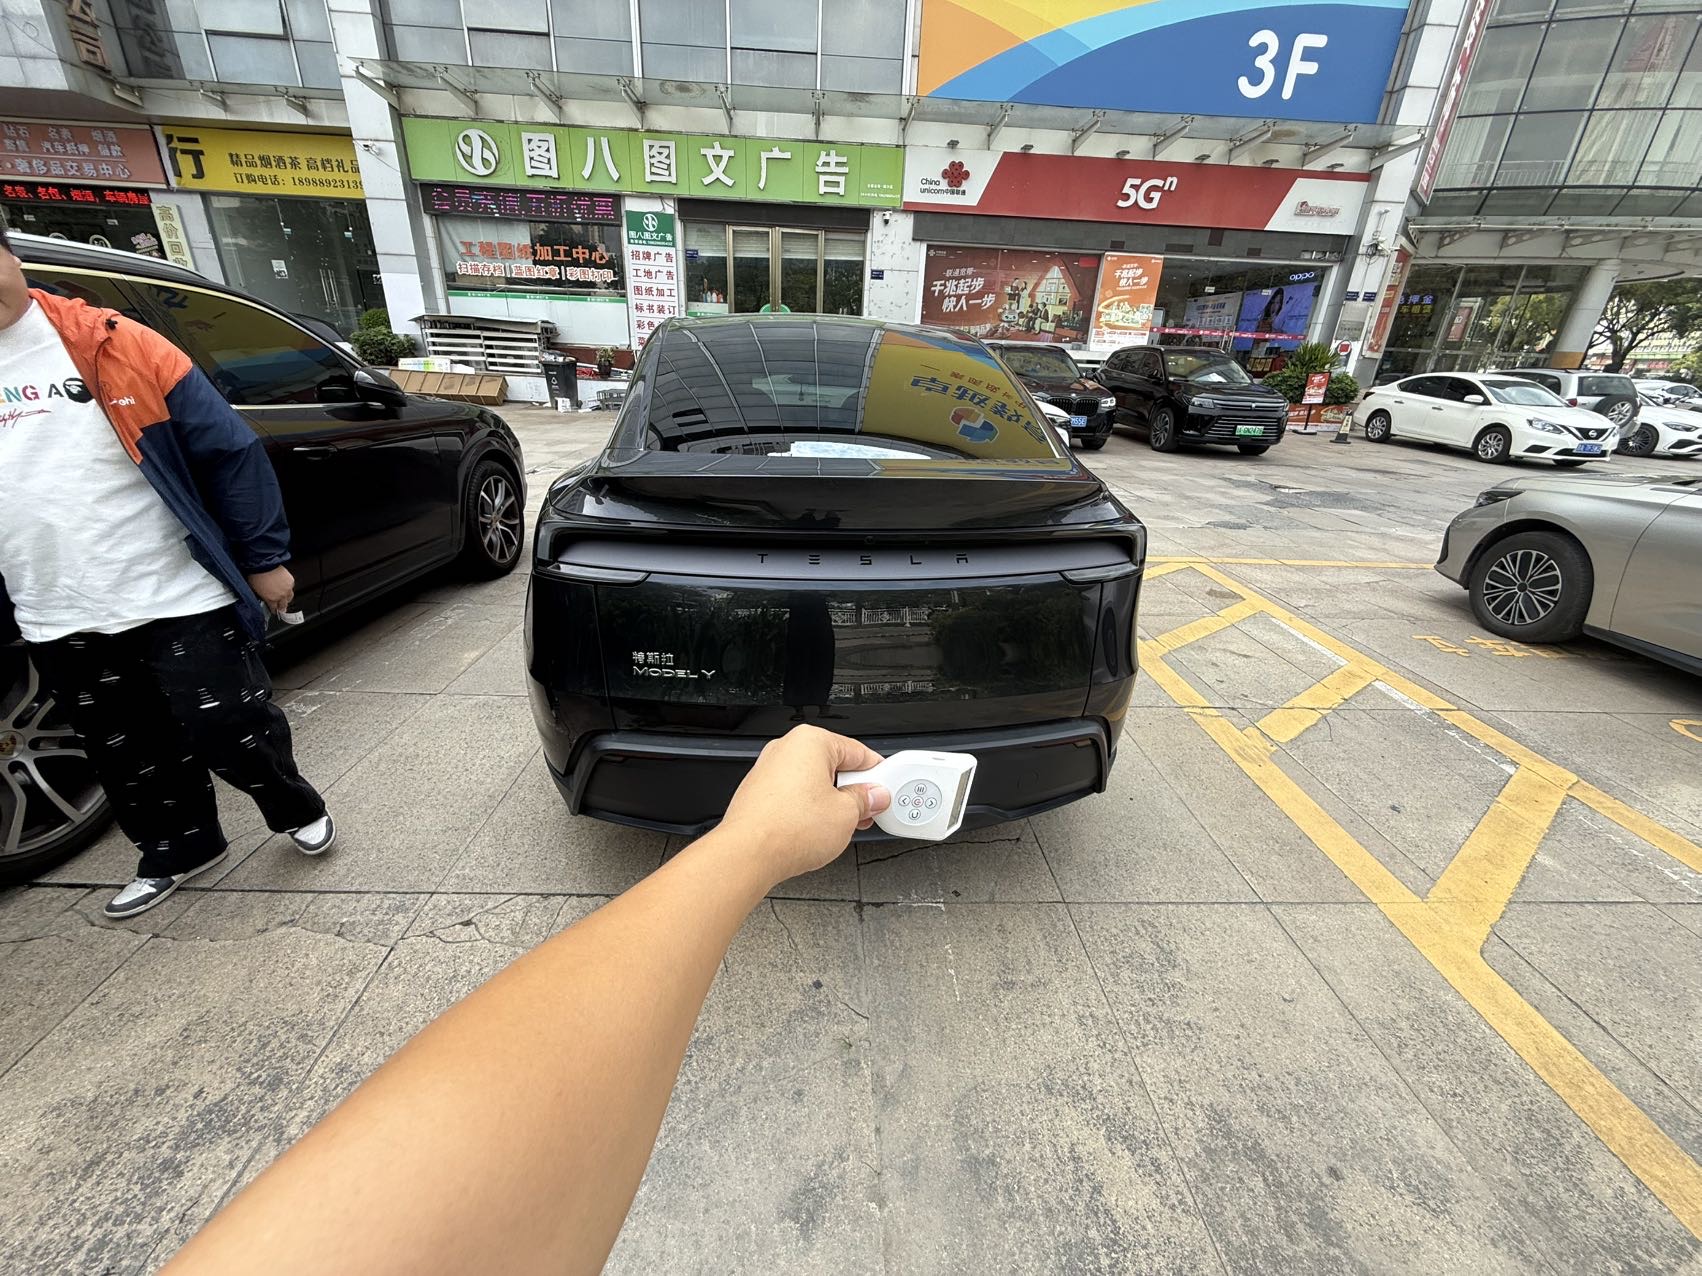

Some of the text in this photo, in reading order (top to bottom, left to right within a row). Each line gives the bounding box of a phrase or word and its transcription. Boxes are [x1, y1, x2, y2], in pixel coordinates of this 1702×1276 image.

[1237, 29, 1328, 100] 3F
[228, 152, 302, 171] 精品烟酒茶
[521, 131, 849, 197] 图八图文广告
[920, 177, 941, 186] China
[628, 230, 673, 241] 图八图文广告
[460, 240, 609, 264] 工程图纸加工中心
[630, 249, 674, 263] 招牌广告
[632, 268, 675, 281] 工地广告
[1289, 271, 1315, 281] oppo
[633, 285, 676, 298] 图纸加工
[931, 277, 985, 297] 千兆起步
[635, 302, 677, 316] 标书装订
[941, 293, 996, 313] 快人一步
[757, 553, 969, 566] TESLA
[632, 651, 674, 665] 特斯拉
[632, 666, 716, 679] MODEL Y
